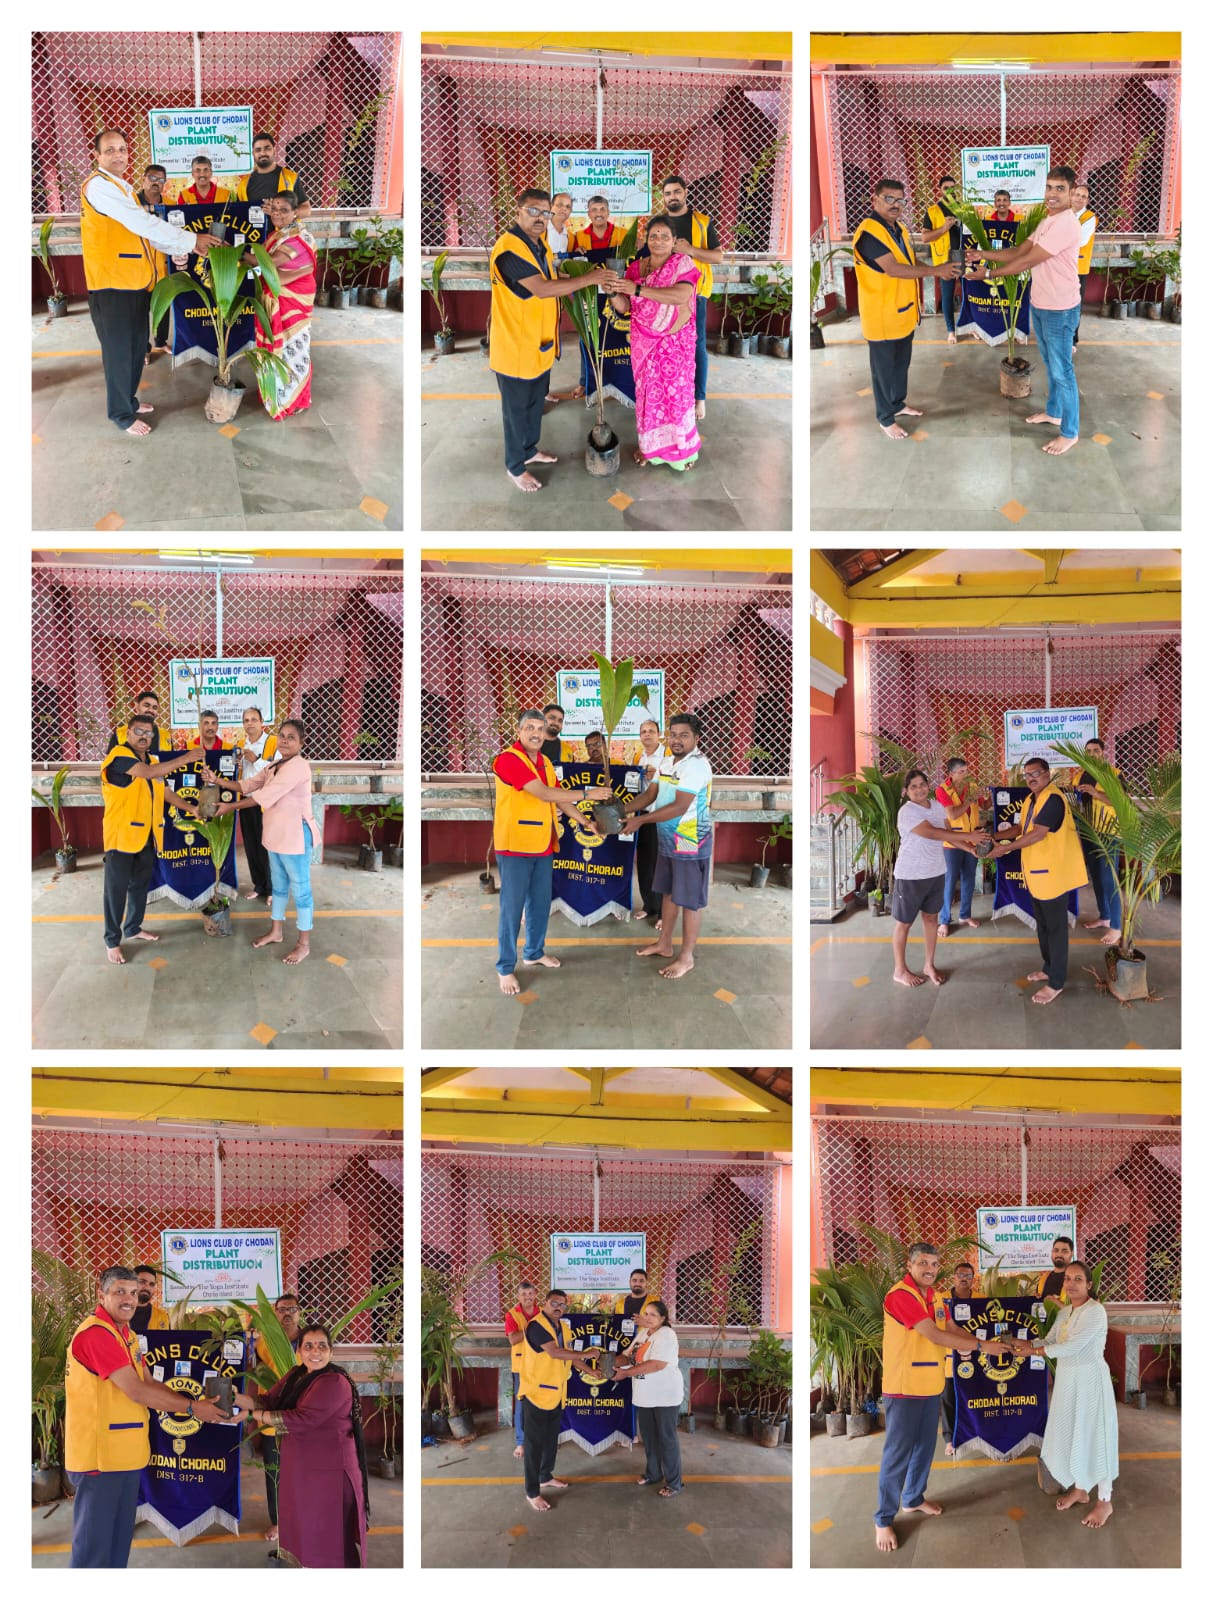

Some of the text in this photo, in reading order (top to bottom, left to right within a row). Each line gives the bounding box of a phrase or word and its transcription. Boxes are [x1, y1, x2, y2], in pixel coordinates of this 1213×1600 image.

[174, 117, 192, 125] LIONS
[213, 116, 220, 124] OF
[222, 115, 247, 123] CHODAN
[188, 126, 217, 134] PLANT
[588, 168, 616, 176] PLANT
[977, 170, 1035, 178] DISTRIBUTIUON
[215, 667, 231, 675] CLUB
[233, 667, 241, 675] OF
[244, 666, 269, 674] CHODAN
[1026, 716, 1042, 724] LIONS
[1070, 714, 1092, 722] CHODAN
[1021, 732, 1082, 741] DISTRIBUTIUON
[1000, 800, 1024, 821] LION
[552, 860, 584, 871] CHODAN
[1047, 1214, 1070, 1222] CHODAN
[1014, 1224, 1041, 1232] PLANT
[190, 1238, 274, 1248] LIONS CLUB OF CHODAN
[206, 1249, 239, 1258] PLANT
[183, 1260, 262, 1270] DISTRIBUTIUON
[600, 1325, 631, 1347] CLUB
[968, 1398, 1000, 1409] CHODAN
[179, 1456, 226, 1472] (CHORAO)
[179, 1474, 204, 1482] 317-B
